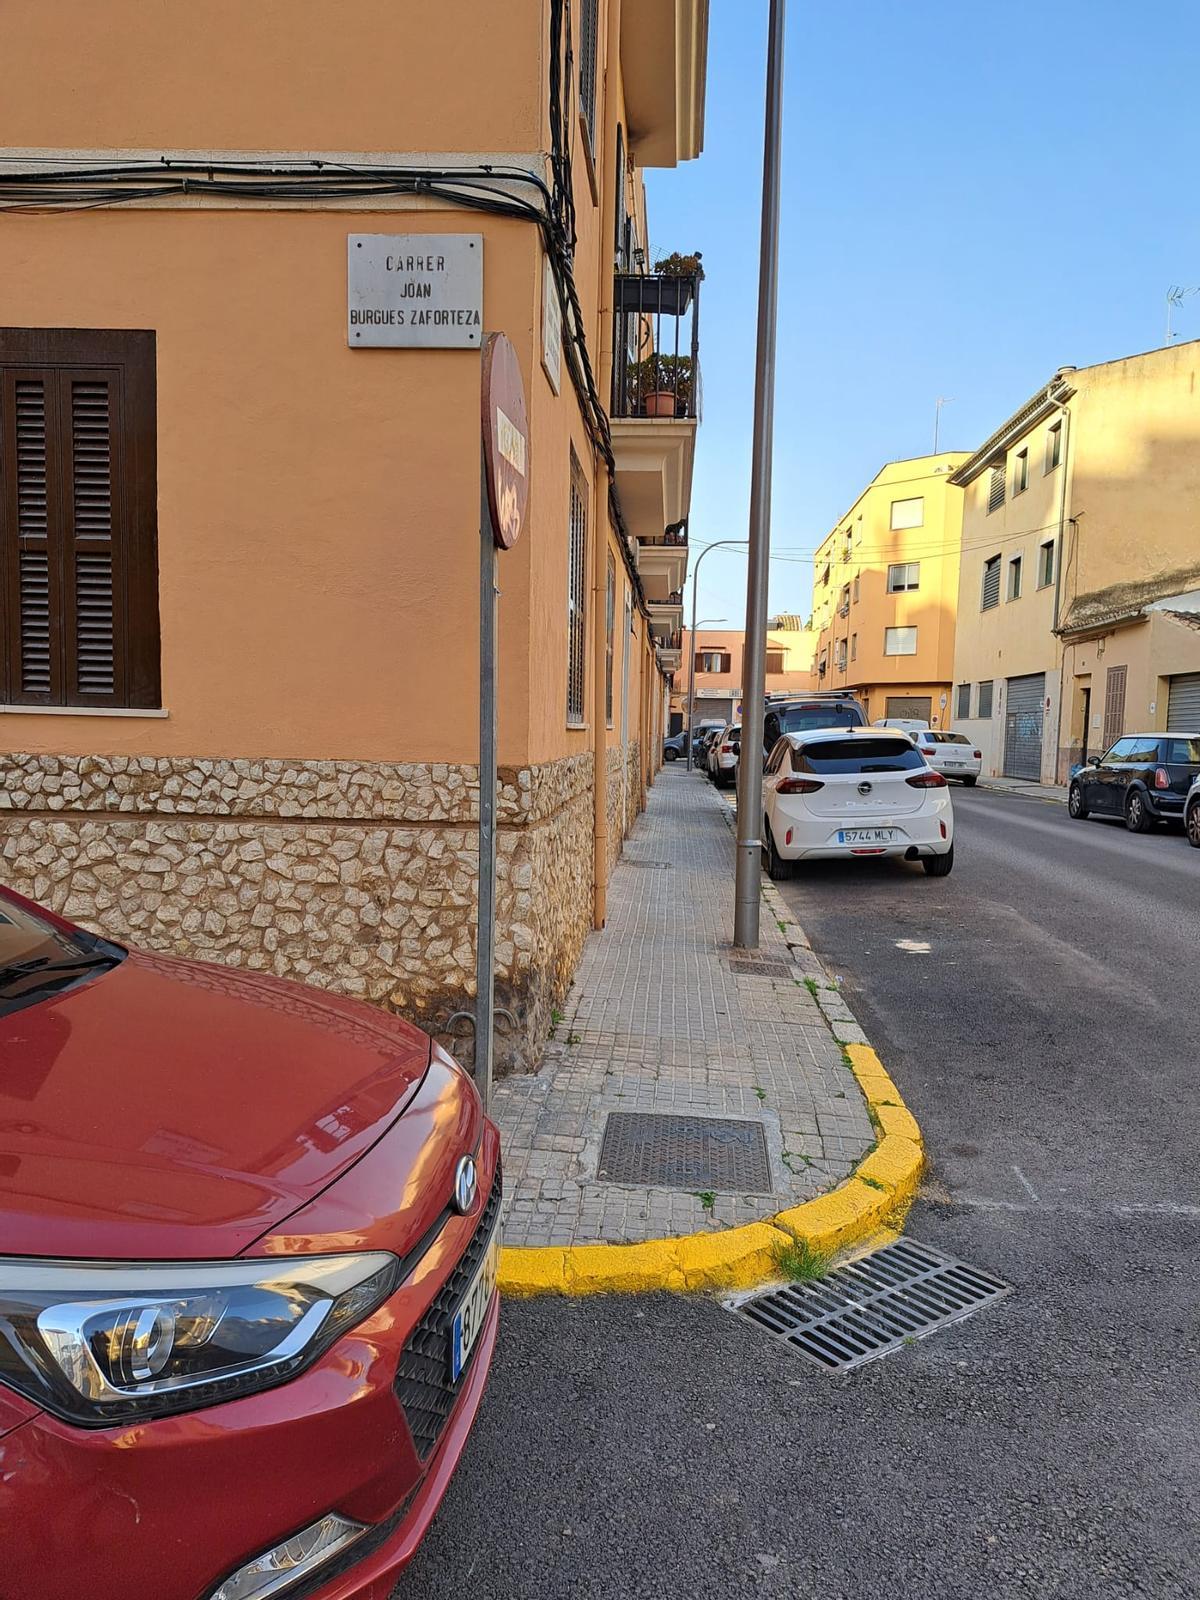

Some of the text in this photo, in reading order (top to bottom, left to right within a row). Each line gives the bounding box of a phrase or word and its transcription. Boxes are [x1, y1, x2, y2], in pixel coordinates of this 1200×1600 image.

[386, 255, 445, 272] CARRER
[400, 282, 432, 298] JOAN
[350, 309, 481, 326] BURGUES ZAFORTEZA
[845, 830, 894, 841] 5744 MLY
